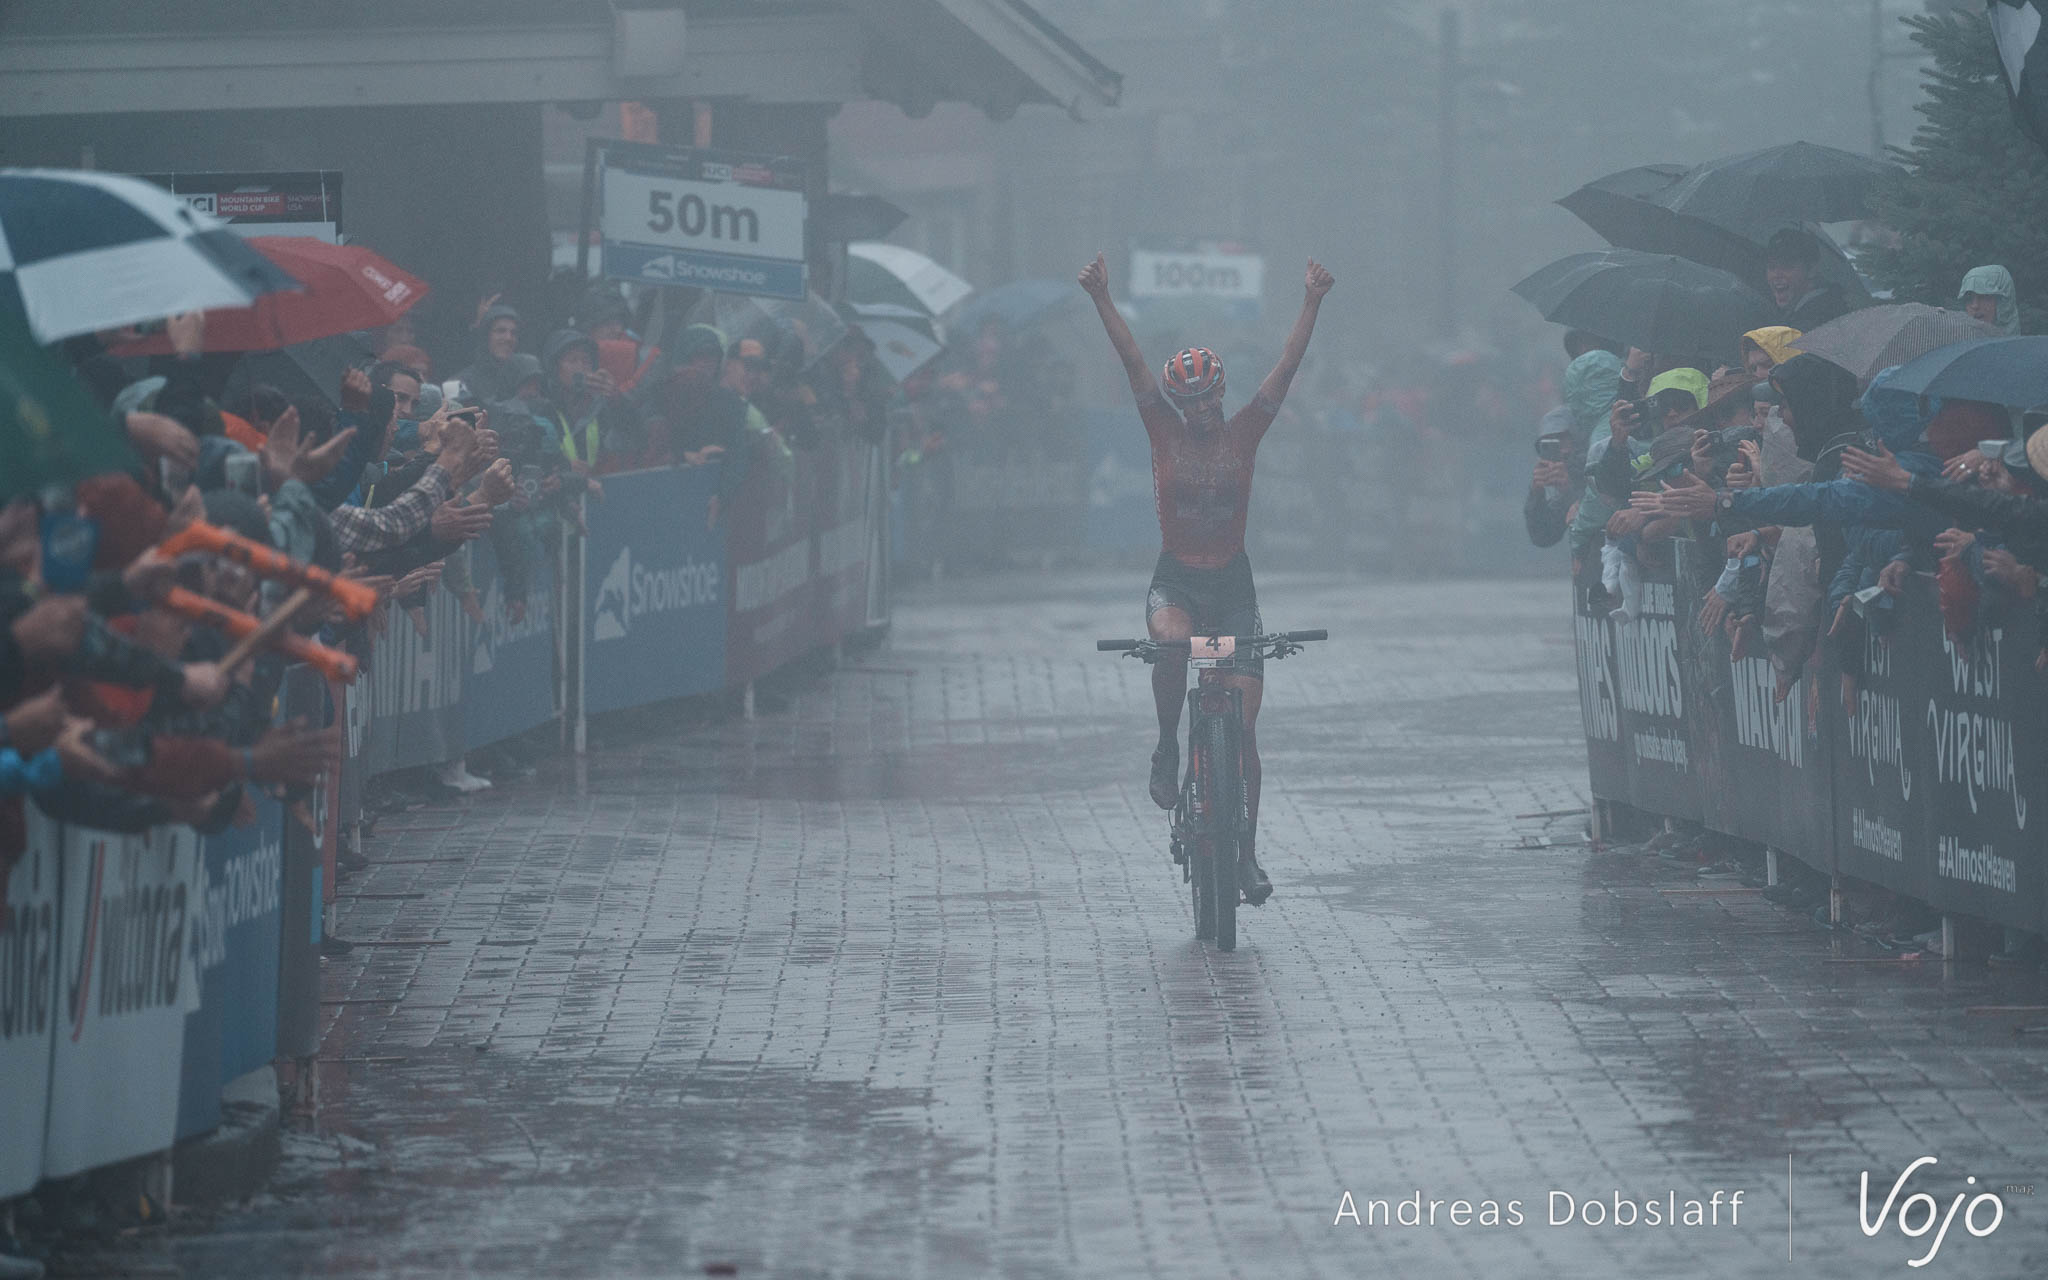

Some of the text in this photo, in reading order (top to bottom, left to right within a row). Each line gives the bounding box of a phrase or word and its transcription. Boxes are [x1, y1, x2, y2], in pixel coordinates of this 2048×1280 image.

[220, 195, 280, 204] MOUNTAIN BIKE
[220, 204, 265, 212] WORLD CUP
[647, 189, 760, 244] 50m
[675, 258, 767, 287] Snowshoe
[1154, 260, 1243, 289] 100m
[632, 555, 719, 616] Snowshoe
[1205, 632, 1222, 652] 4
[1927, 698, 2026, 831] VIRGINIA
[1853, 807, 1903, 863] #AlmostHeaven
[1939, 835, 2017, 893] #AlmostHeaven
